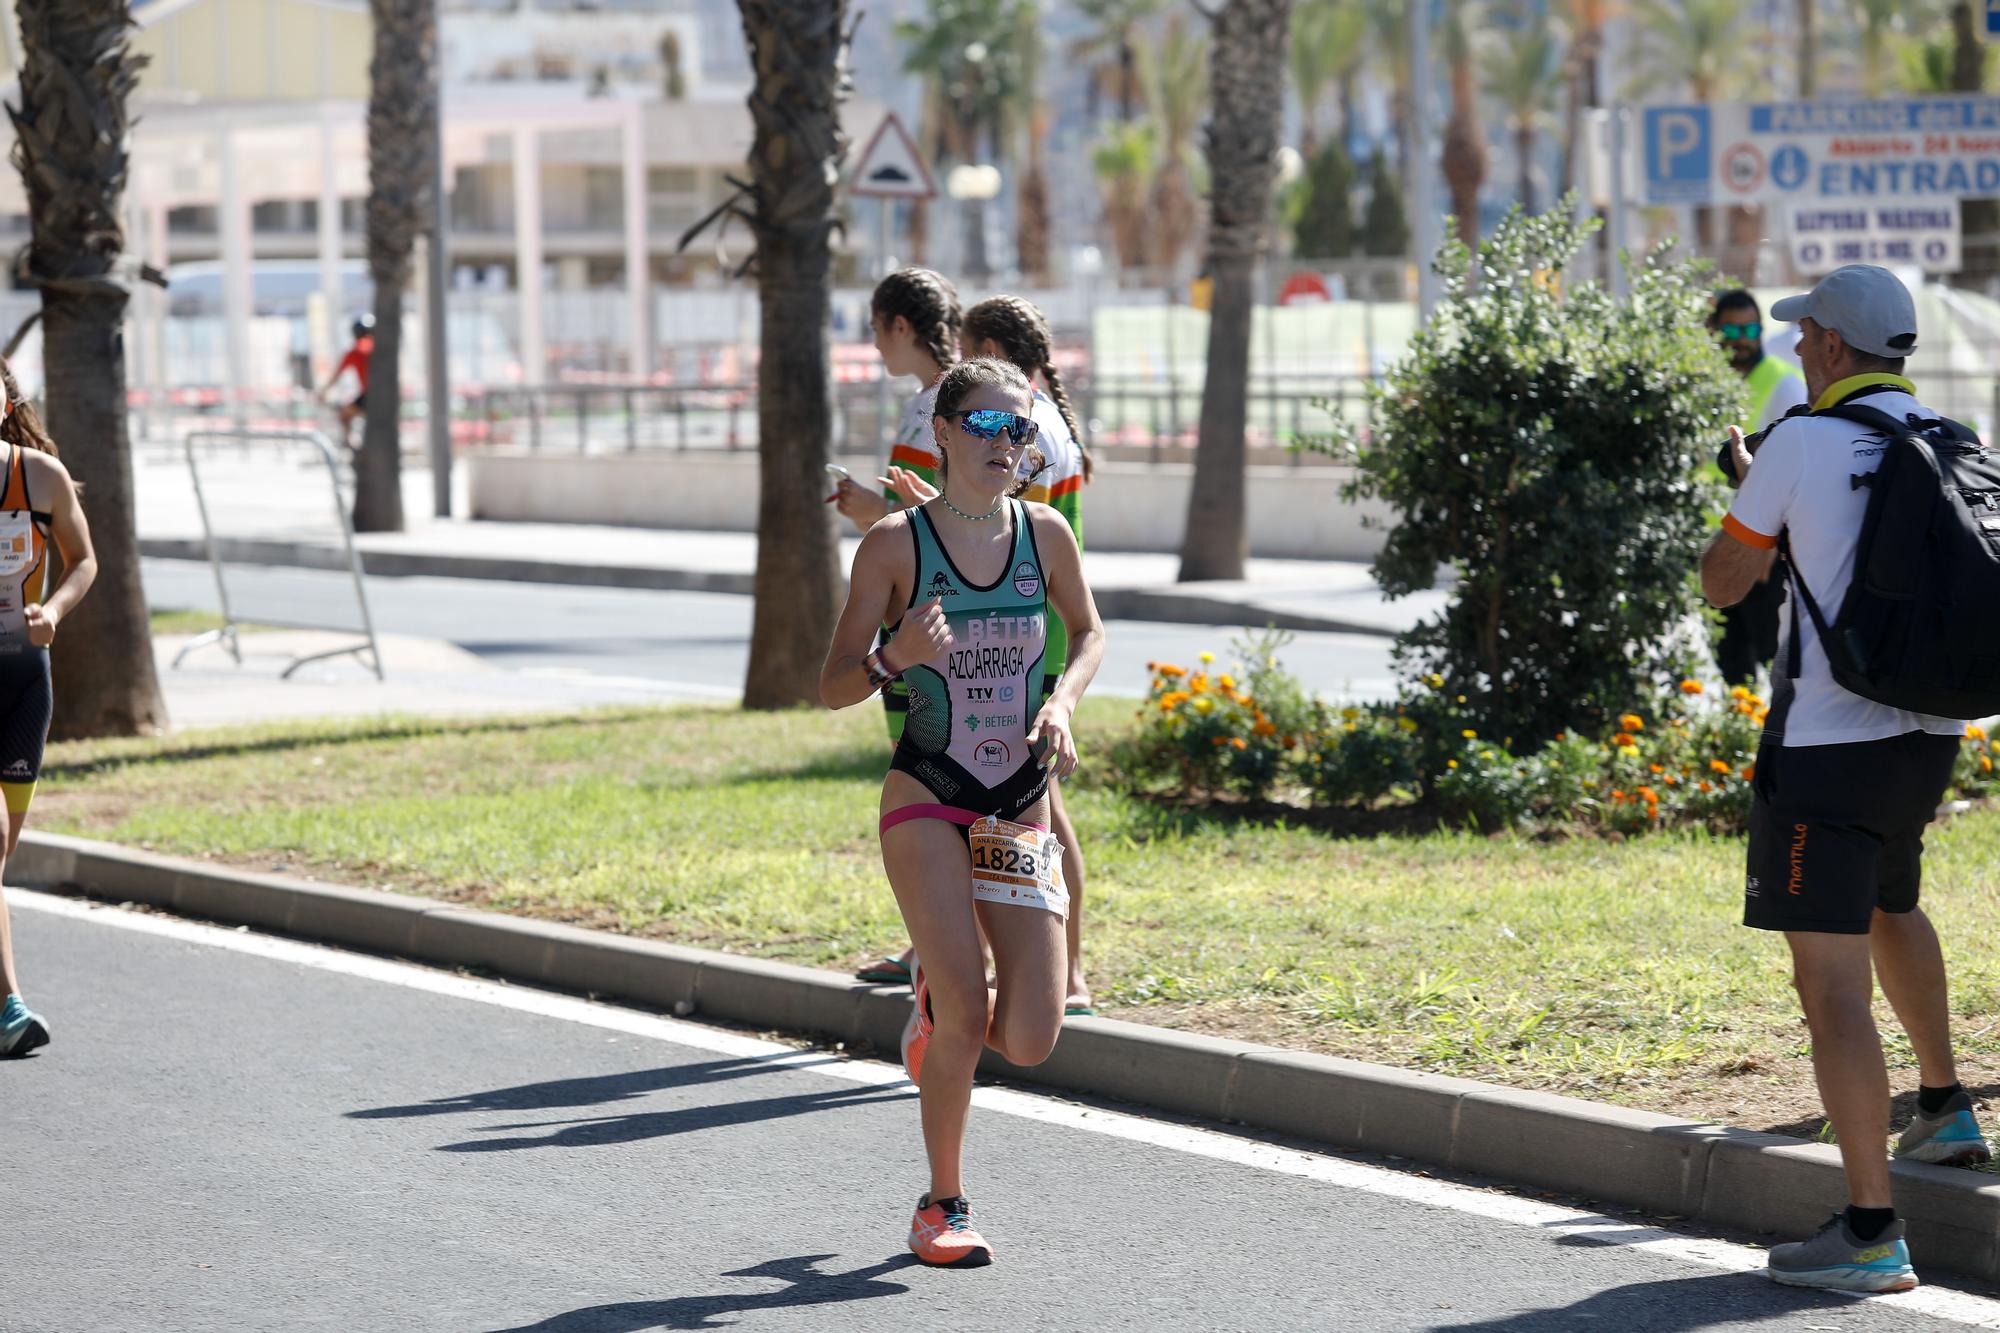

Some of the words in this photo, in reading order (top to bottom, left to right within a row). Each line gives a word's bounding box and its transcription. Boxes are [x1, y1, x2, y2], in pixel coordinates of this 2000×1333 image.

[1771, 104, 1905, 135] PARKING
[1659, 115, 1699, 178] P
[949, 642, 1024, 679] AZCÁRRAGA
[967, 688, 993, 699] ITV
[975, 846, 1035, 875] 1823
